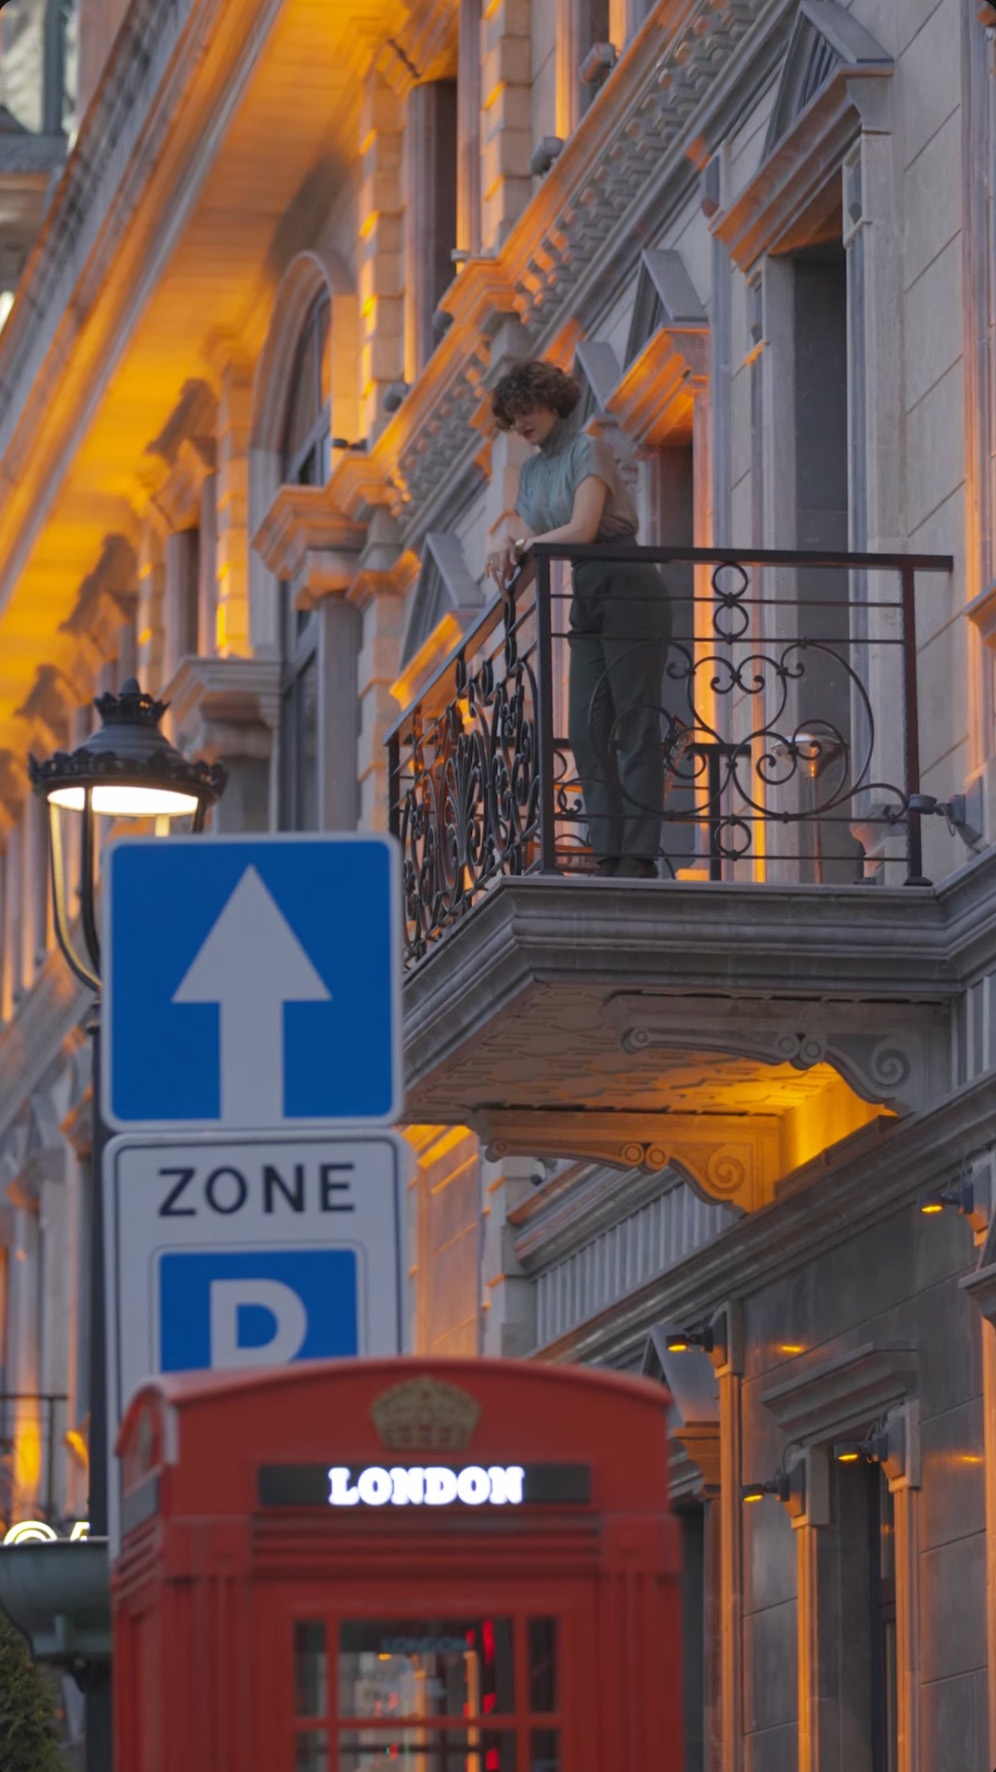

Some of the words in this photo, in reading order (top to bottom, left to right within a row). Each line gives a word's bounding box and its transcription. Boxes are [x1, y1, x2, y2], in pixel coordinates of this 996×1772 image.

[158, 1163, 355, 1217] ZONE
[210, 1278, 307, 1369] P
[328, 1465, 525, 1506] LONDON
